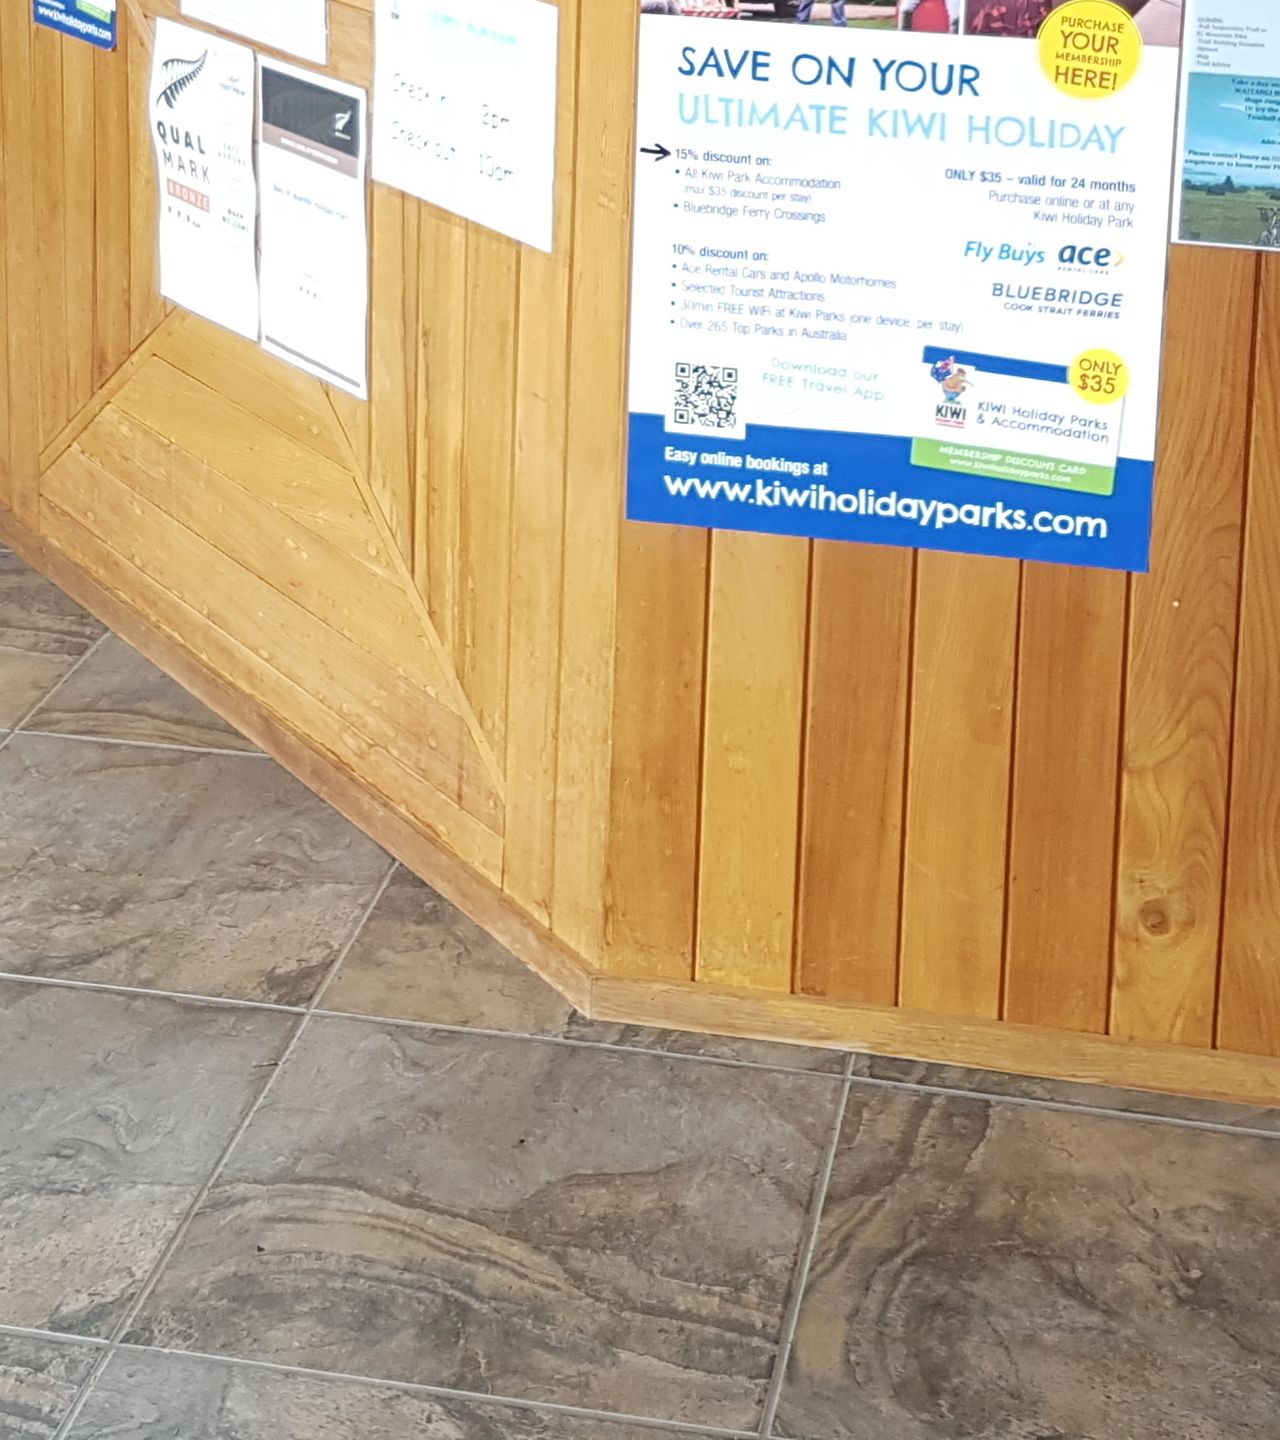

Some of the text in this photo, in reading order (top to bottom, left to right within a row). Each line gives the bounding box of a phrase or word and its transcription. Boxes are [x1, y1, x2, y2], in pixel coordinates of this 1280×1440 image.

[1060, 15, 1125, 34] PURCHASE
[1059, 30, 1119, 55] YOUR
[1055, 51, 1122, 67] MEMBERSHIP
[677, 46, 980, 97] SAVE ON YOUR
[1055, 66, 1118, 91] HERE!
[677, 94, 1125, 154] ULTIMATE KIWI HOLIDAY
[157, 120, 206, 155] QUAL
[163, 149, 210, 184] MARK
[675, 149, 772, 166] 15% discount on:
[701, 169, 723, 180] Kiwi
[727, 171, 750, 183] Park
[755, 173, 841, 189] Accommodation
[945, 168, 1136, 193] ONLY $35 valid for 24 months
[168, 179, 209, 212] BRONZE
[988, 190, 1135, 214] Purchase online or at any
[684, 201, 826, 224] Bluebridge Ferry Crossings
[1033, 211, 1134, 228] Kiwi Holiday Park
[672, 244, 769, 261] 10% discount on:
[964, 240, 1045, 266] Fly Buys
[1058, 244, 1111, 267] ace
[742, 267, 766, 280] Cars
[770, 269, 789, 281] and
[992, 283, 1124, 307] BLUEBRIDGE
[1004, 302, 1120, 319] COOK STRAIT FERRIES
[1079, 358, 1122, 376] ONLY
[1078, 374, 1115, 394] $35
[936, 403, 967, 421] KIWI
[977, 401, 1108, 430] KIWI Holiday Parks
[976, 414, 985, 424] &
[991, 416, 1109, 444] Accommodation
[664, 447, 828, 476] Easy online bookings at
[664, 474, 1108, 538] www.kiwiholidayparks.com
